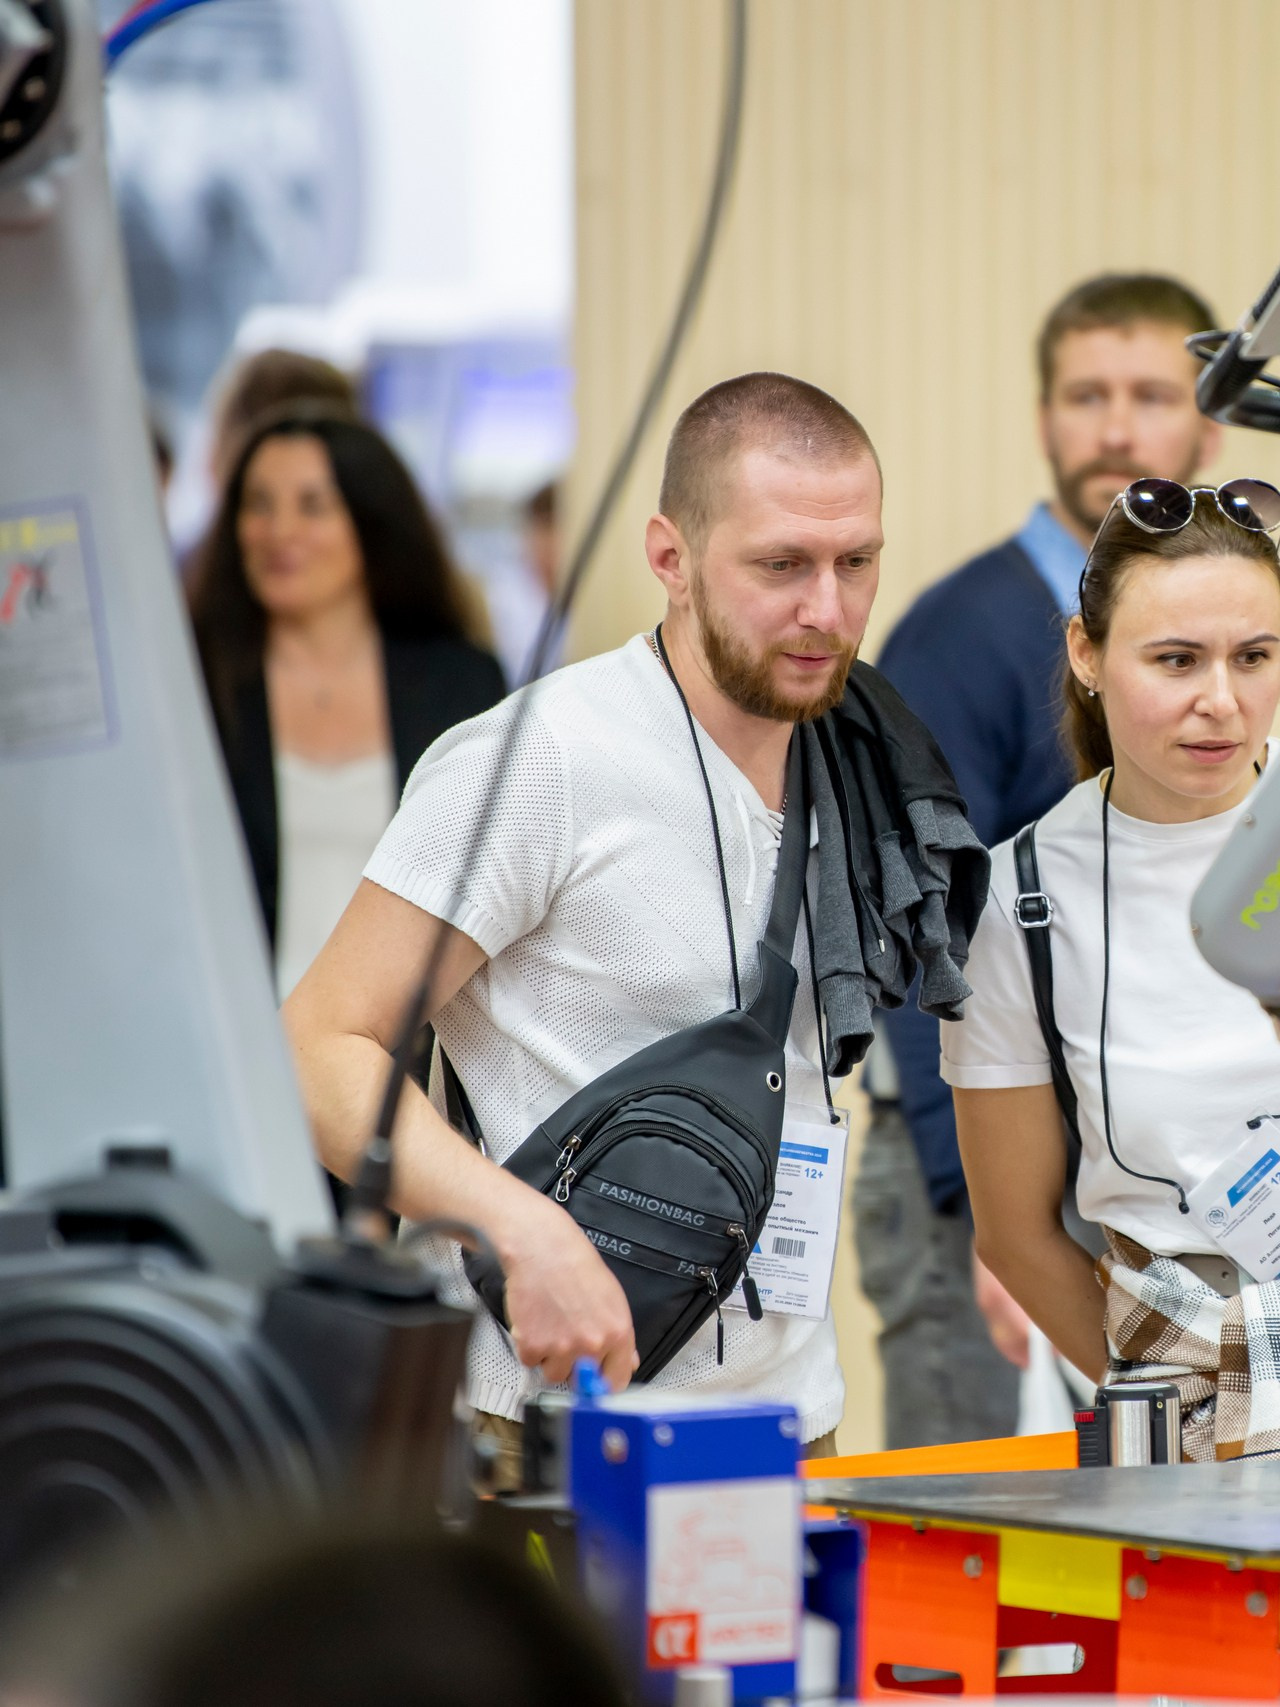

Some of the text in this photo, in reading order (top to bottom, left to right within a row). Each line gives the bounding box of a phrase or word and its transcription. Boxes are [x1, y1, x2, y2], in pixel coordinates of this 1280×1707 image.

[804, 1167, 824, 1179] 12+
[599, 1182, 705, 1227] FASHIONBAG
[584, 1229, 632, 1255] NBAG
